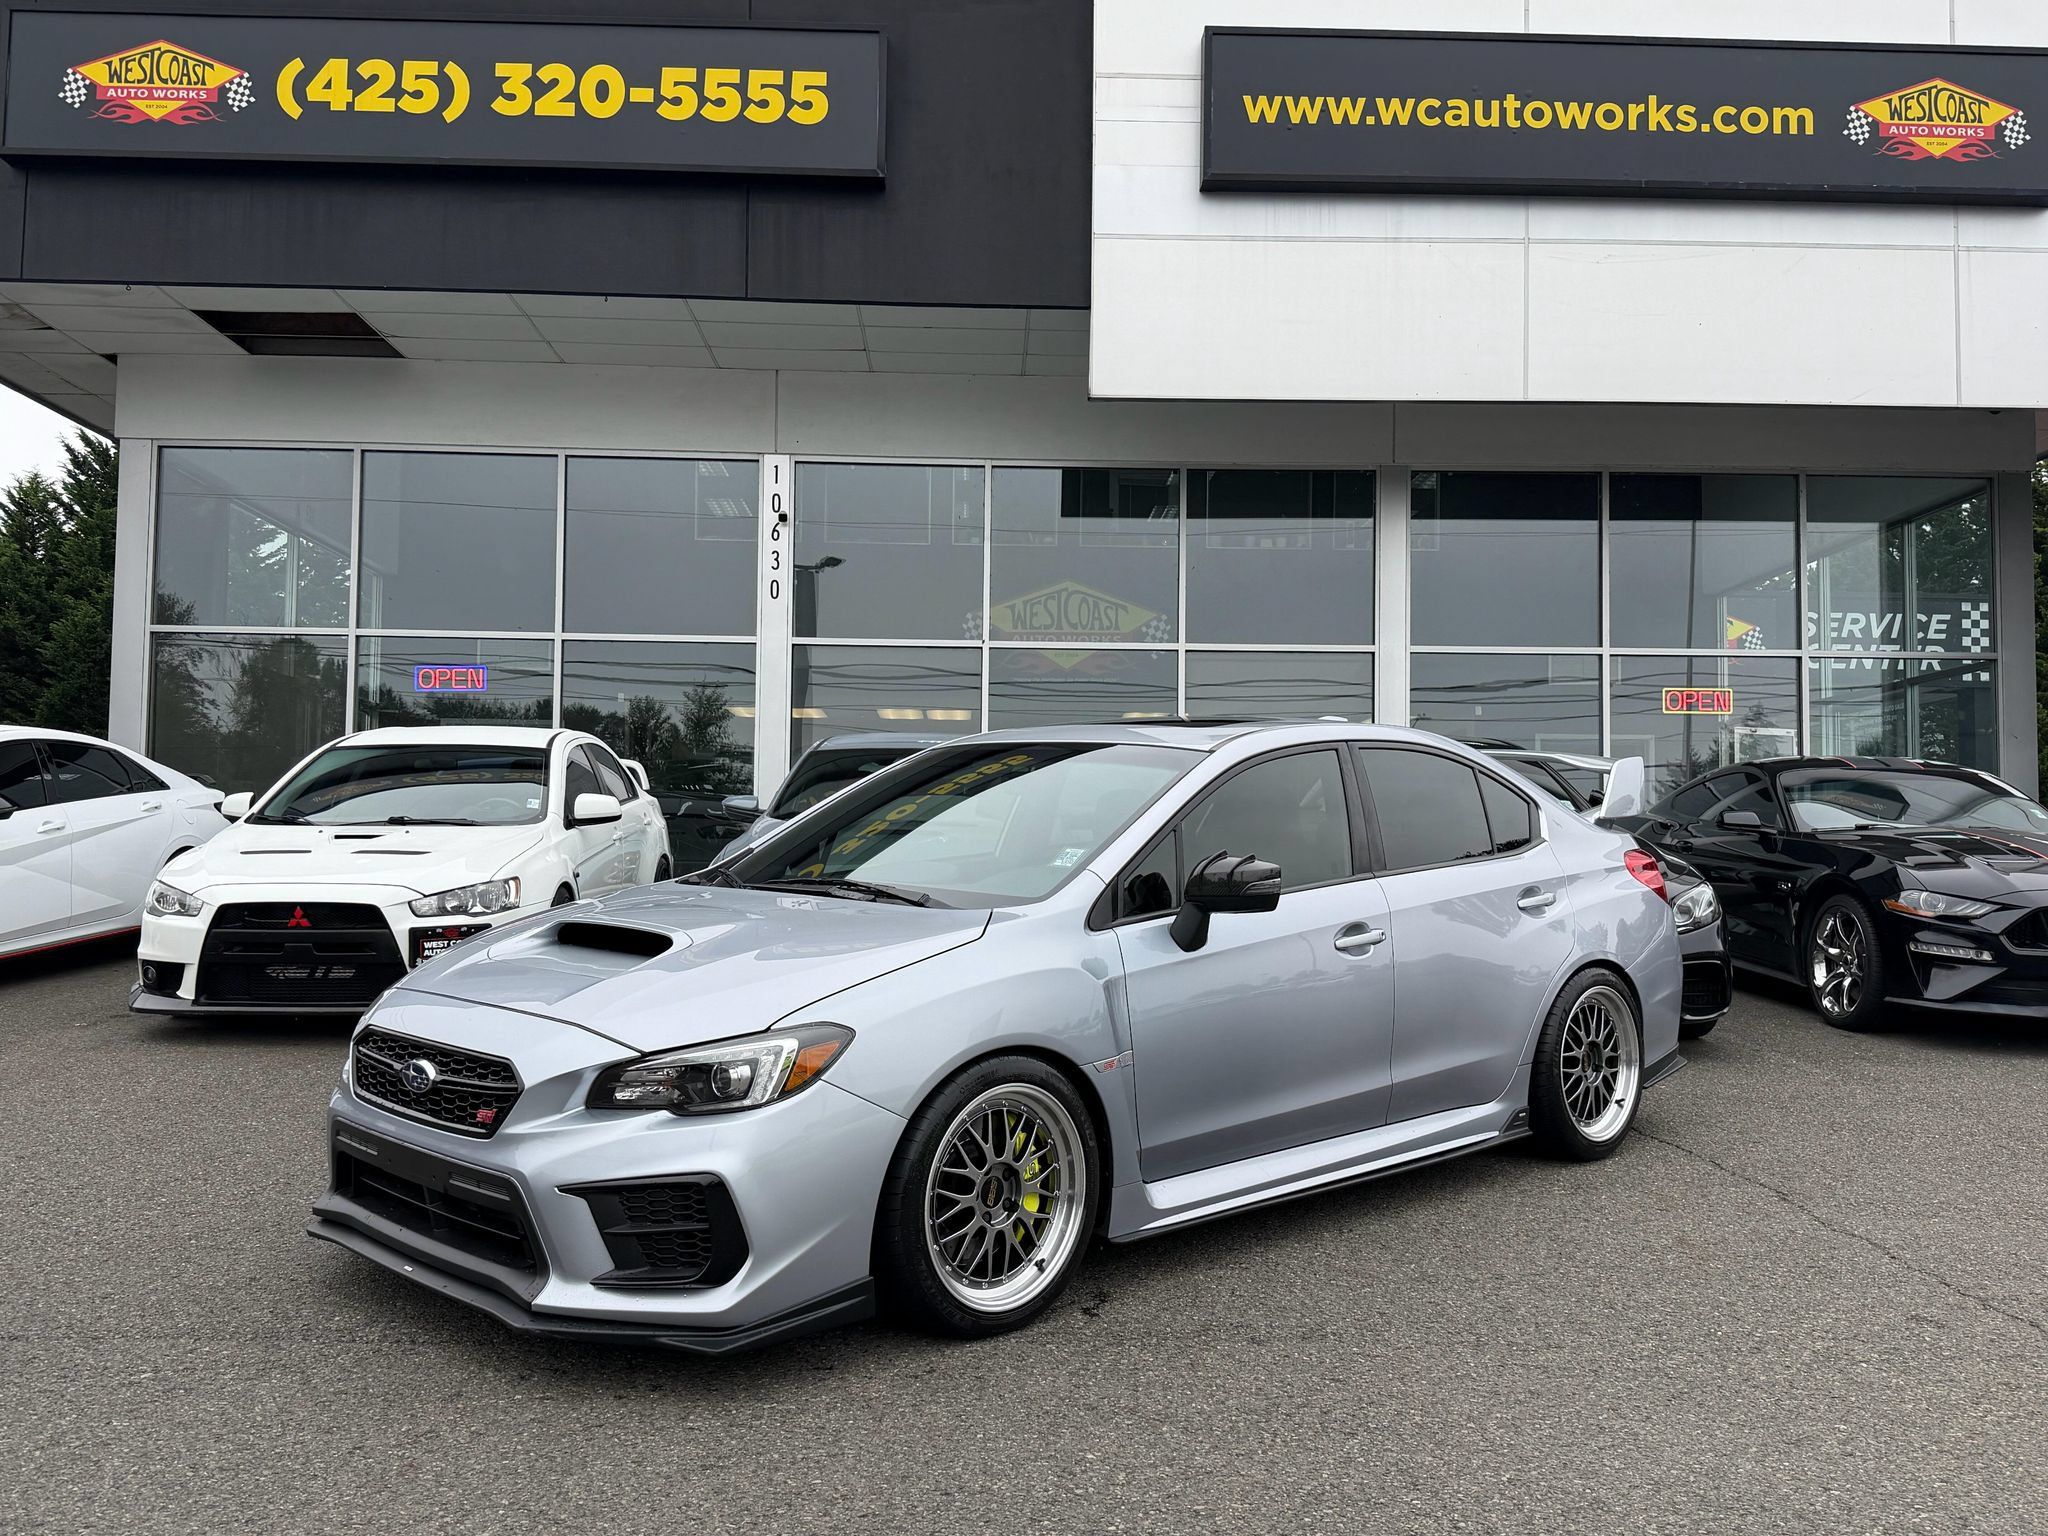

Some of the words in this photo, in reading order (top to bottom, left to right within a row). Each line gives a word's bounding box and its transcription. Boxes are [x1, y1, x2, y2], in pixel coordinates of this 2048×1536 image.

[106, 88, 149, 98] AUTO
[153, 89, 207, 99] WORKS
[276, 57, 471, 123] (425)
[490, 62, 829, 125] 320-5555
[1243, 93, 1814, 135] www.wcautoworks.com
[1889, 126, 1929, 135] AUTO
[1933, 127, 1985, 137] WORKS
[418, 668, 484, 689] OPEN
[1666, 690, 1729, 712] OPEN
[423, 940, 449, 949] WEST
